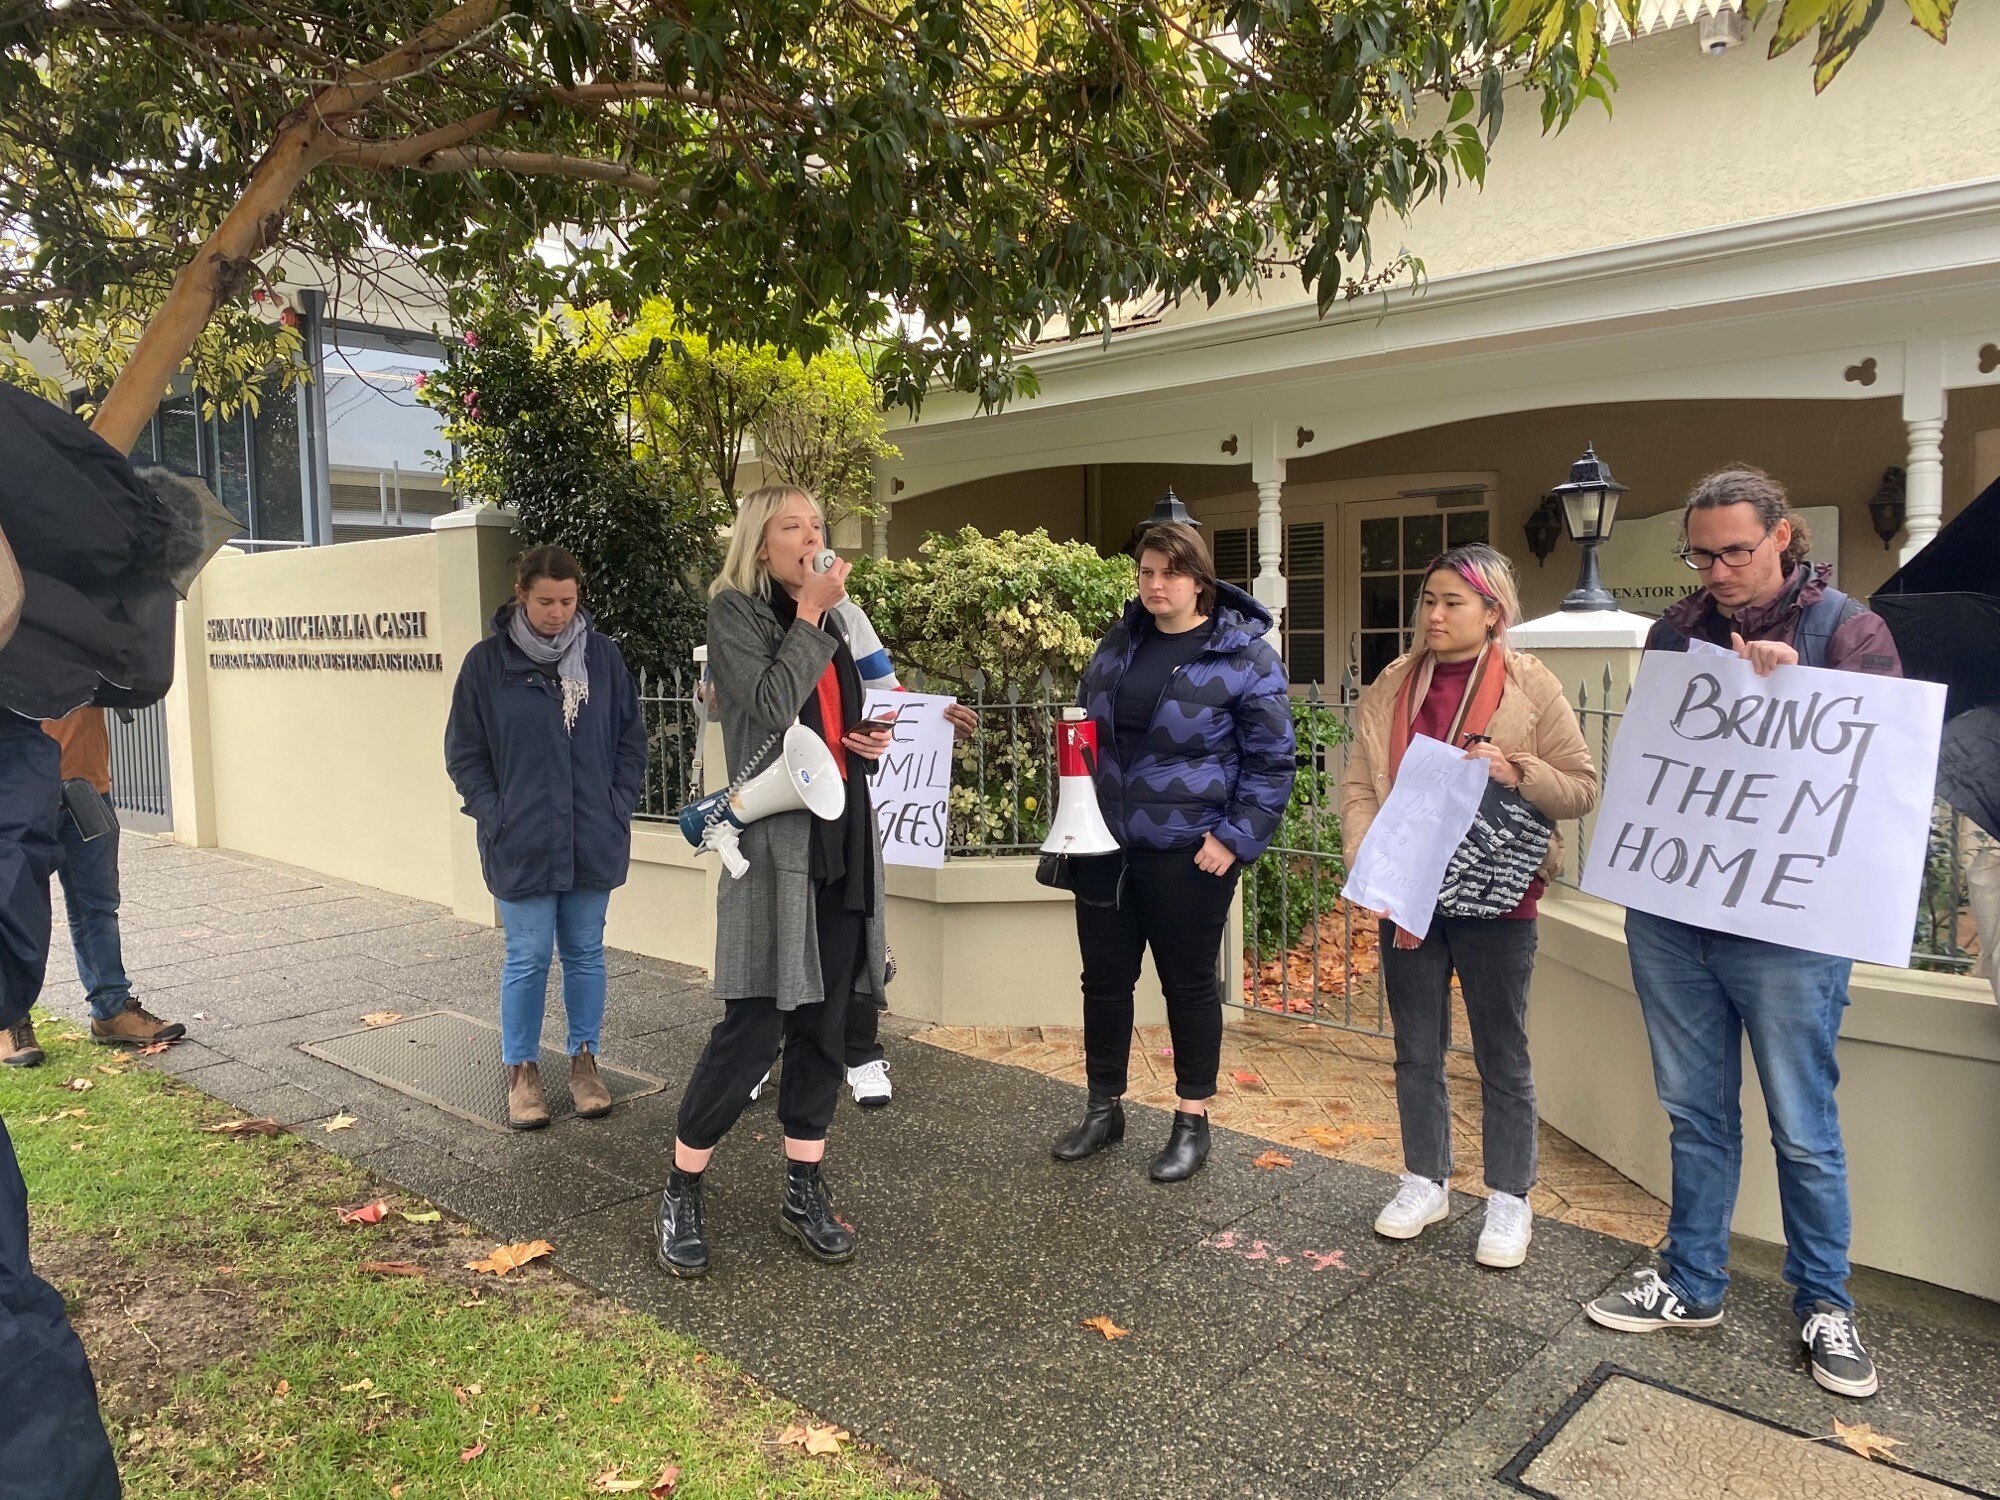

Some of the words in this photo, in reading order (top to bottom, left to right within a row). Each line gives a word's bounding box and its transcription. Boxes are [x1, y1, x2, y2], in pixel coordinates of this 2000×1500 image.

[206, 617, 273, 641] SENATOR
[274, 613, 373, 640] MICHAELIA
[373, 611, 427, 638] CASH
[209, 653, 248, 670] LIBERAL
[248, 653, 297, 671] SENATOR
[297, 653, 321, 671] FOR
[320, 653, 377, 671] WESTERN
[1669, 672, 1879, 779] BRING
[1642, 753, 1859, 857] THEM
[1608, 821, 1826, 909] HOME
